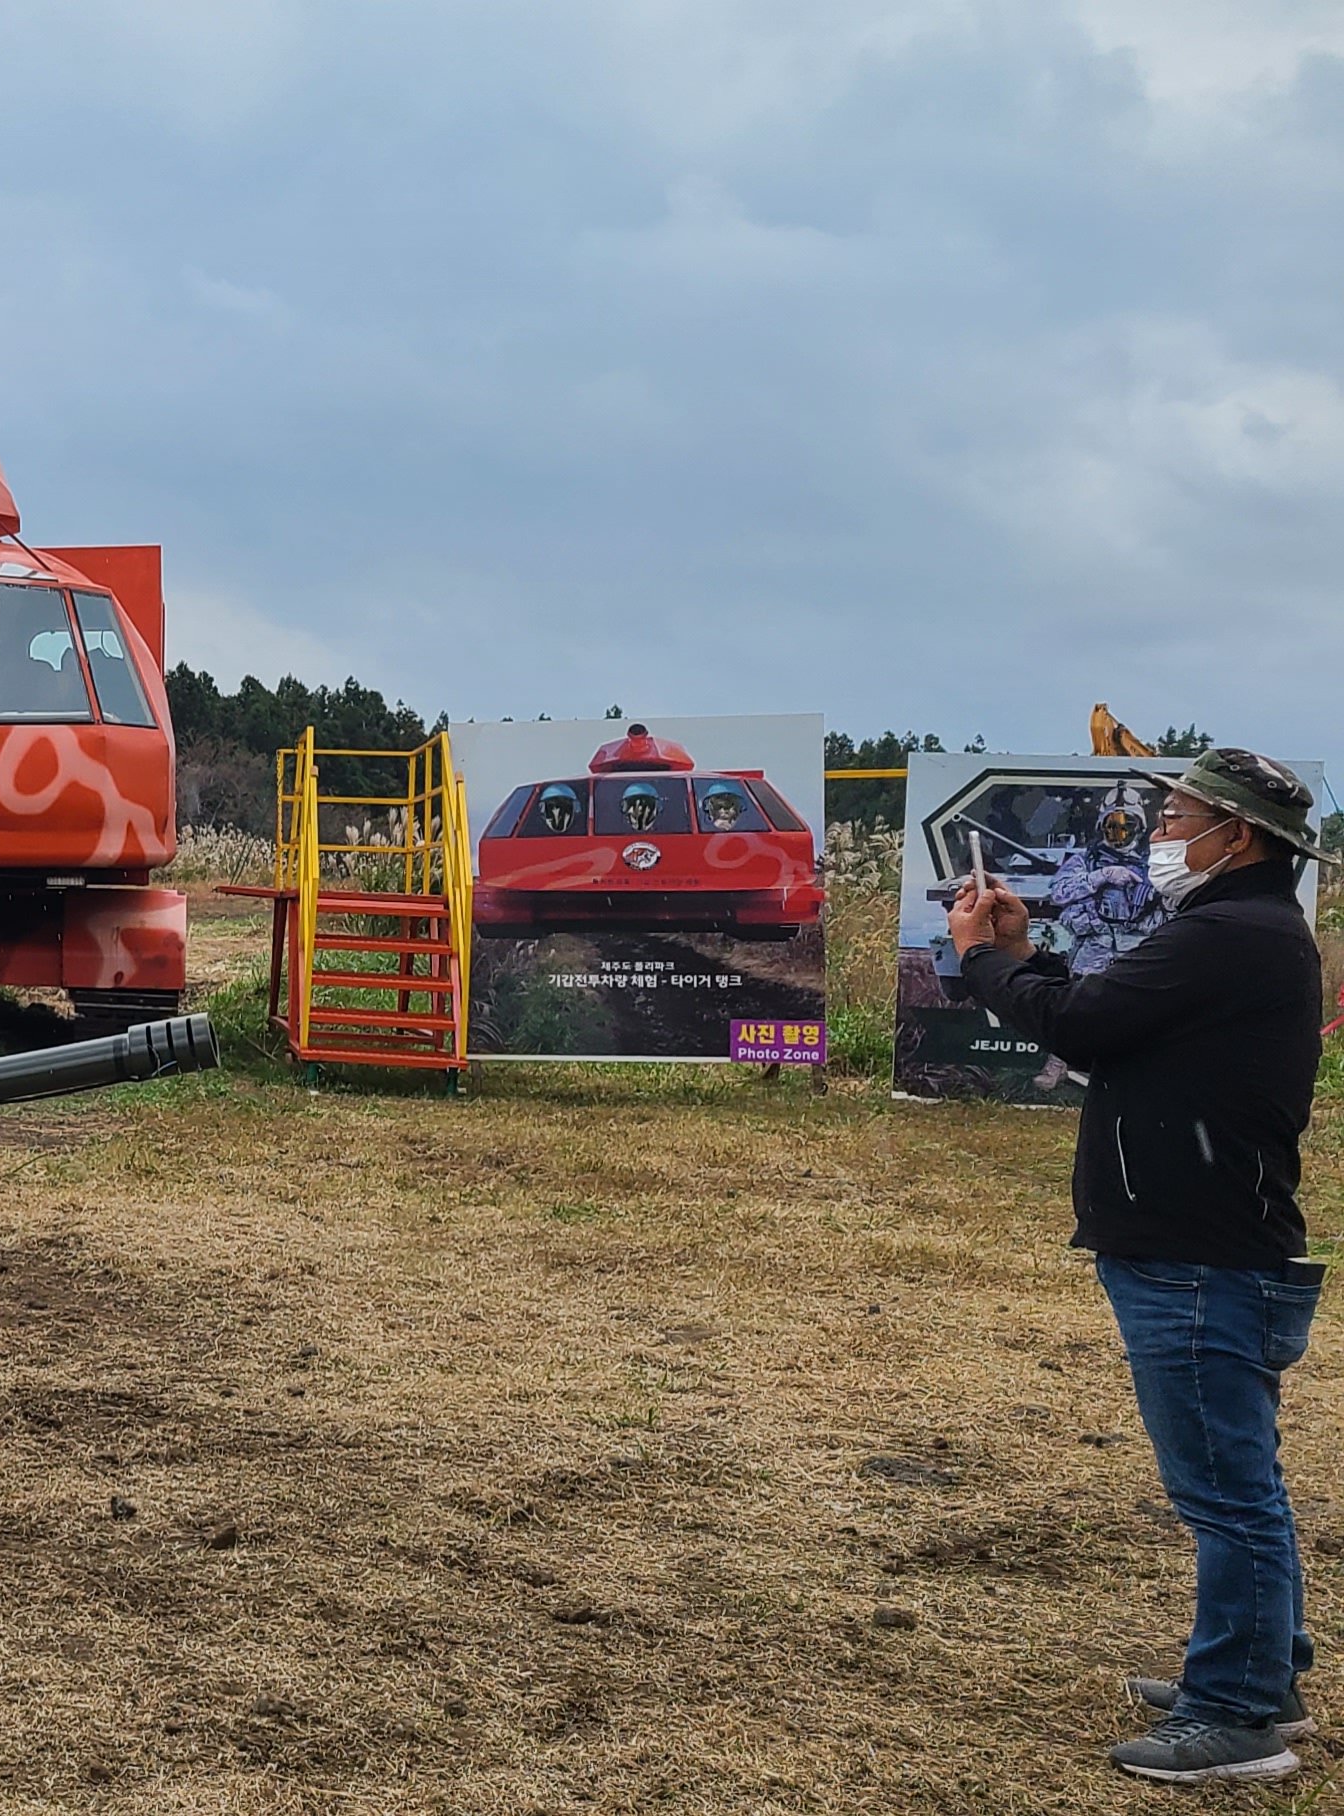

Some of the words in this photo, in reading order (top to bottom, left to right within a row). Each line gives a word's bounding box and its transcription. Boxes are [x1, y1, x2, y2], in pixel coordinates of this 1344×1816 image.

[601, 961, 631, 971] 제주도
[548, 974, 627, 988] 기갑전투차량
[631, 974, 657, 988] 체험
[671, 974, 711, 988] 타이거
[715, 974, 742, 988] 탱크
[737, 1023, 775, 1045] 사진
[782, 1024, 820, 1046] 촬영
[970, 1039, 1011, 1052] JEJU
[738, 1047, 780, 1059] Photo
[783, 1048, 820, 1060] Zone
